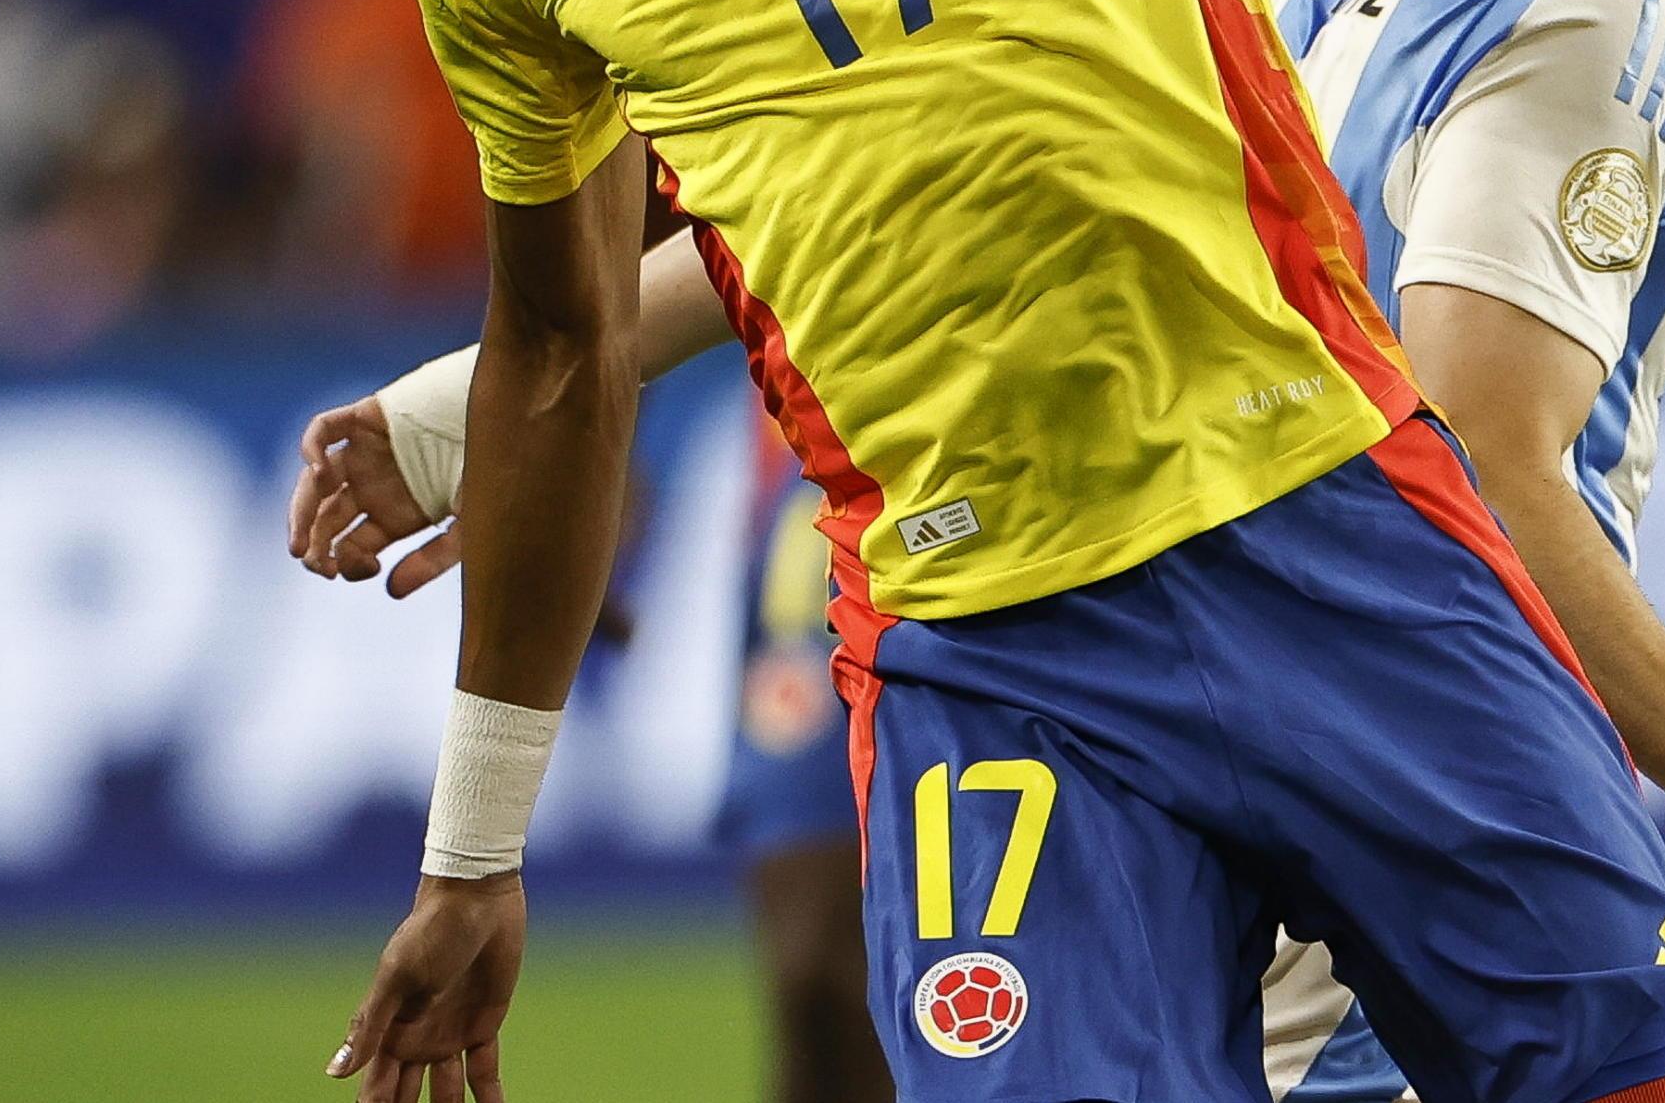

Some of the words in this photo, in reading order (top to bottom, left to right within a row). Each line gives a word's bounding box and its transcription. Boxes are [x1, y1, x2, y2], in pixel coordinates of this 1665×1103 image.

[1234, 384, 1282, 417] HEAT
[1286, 374, 1324, 403] RDY
[914, 758, 1058, 940] 17
